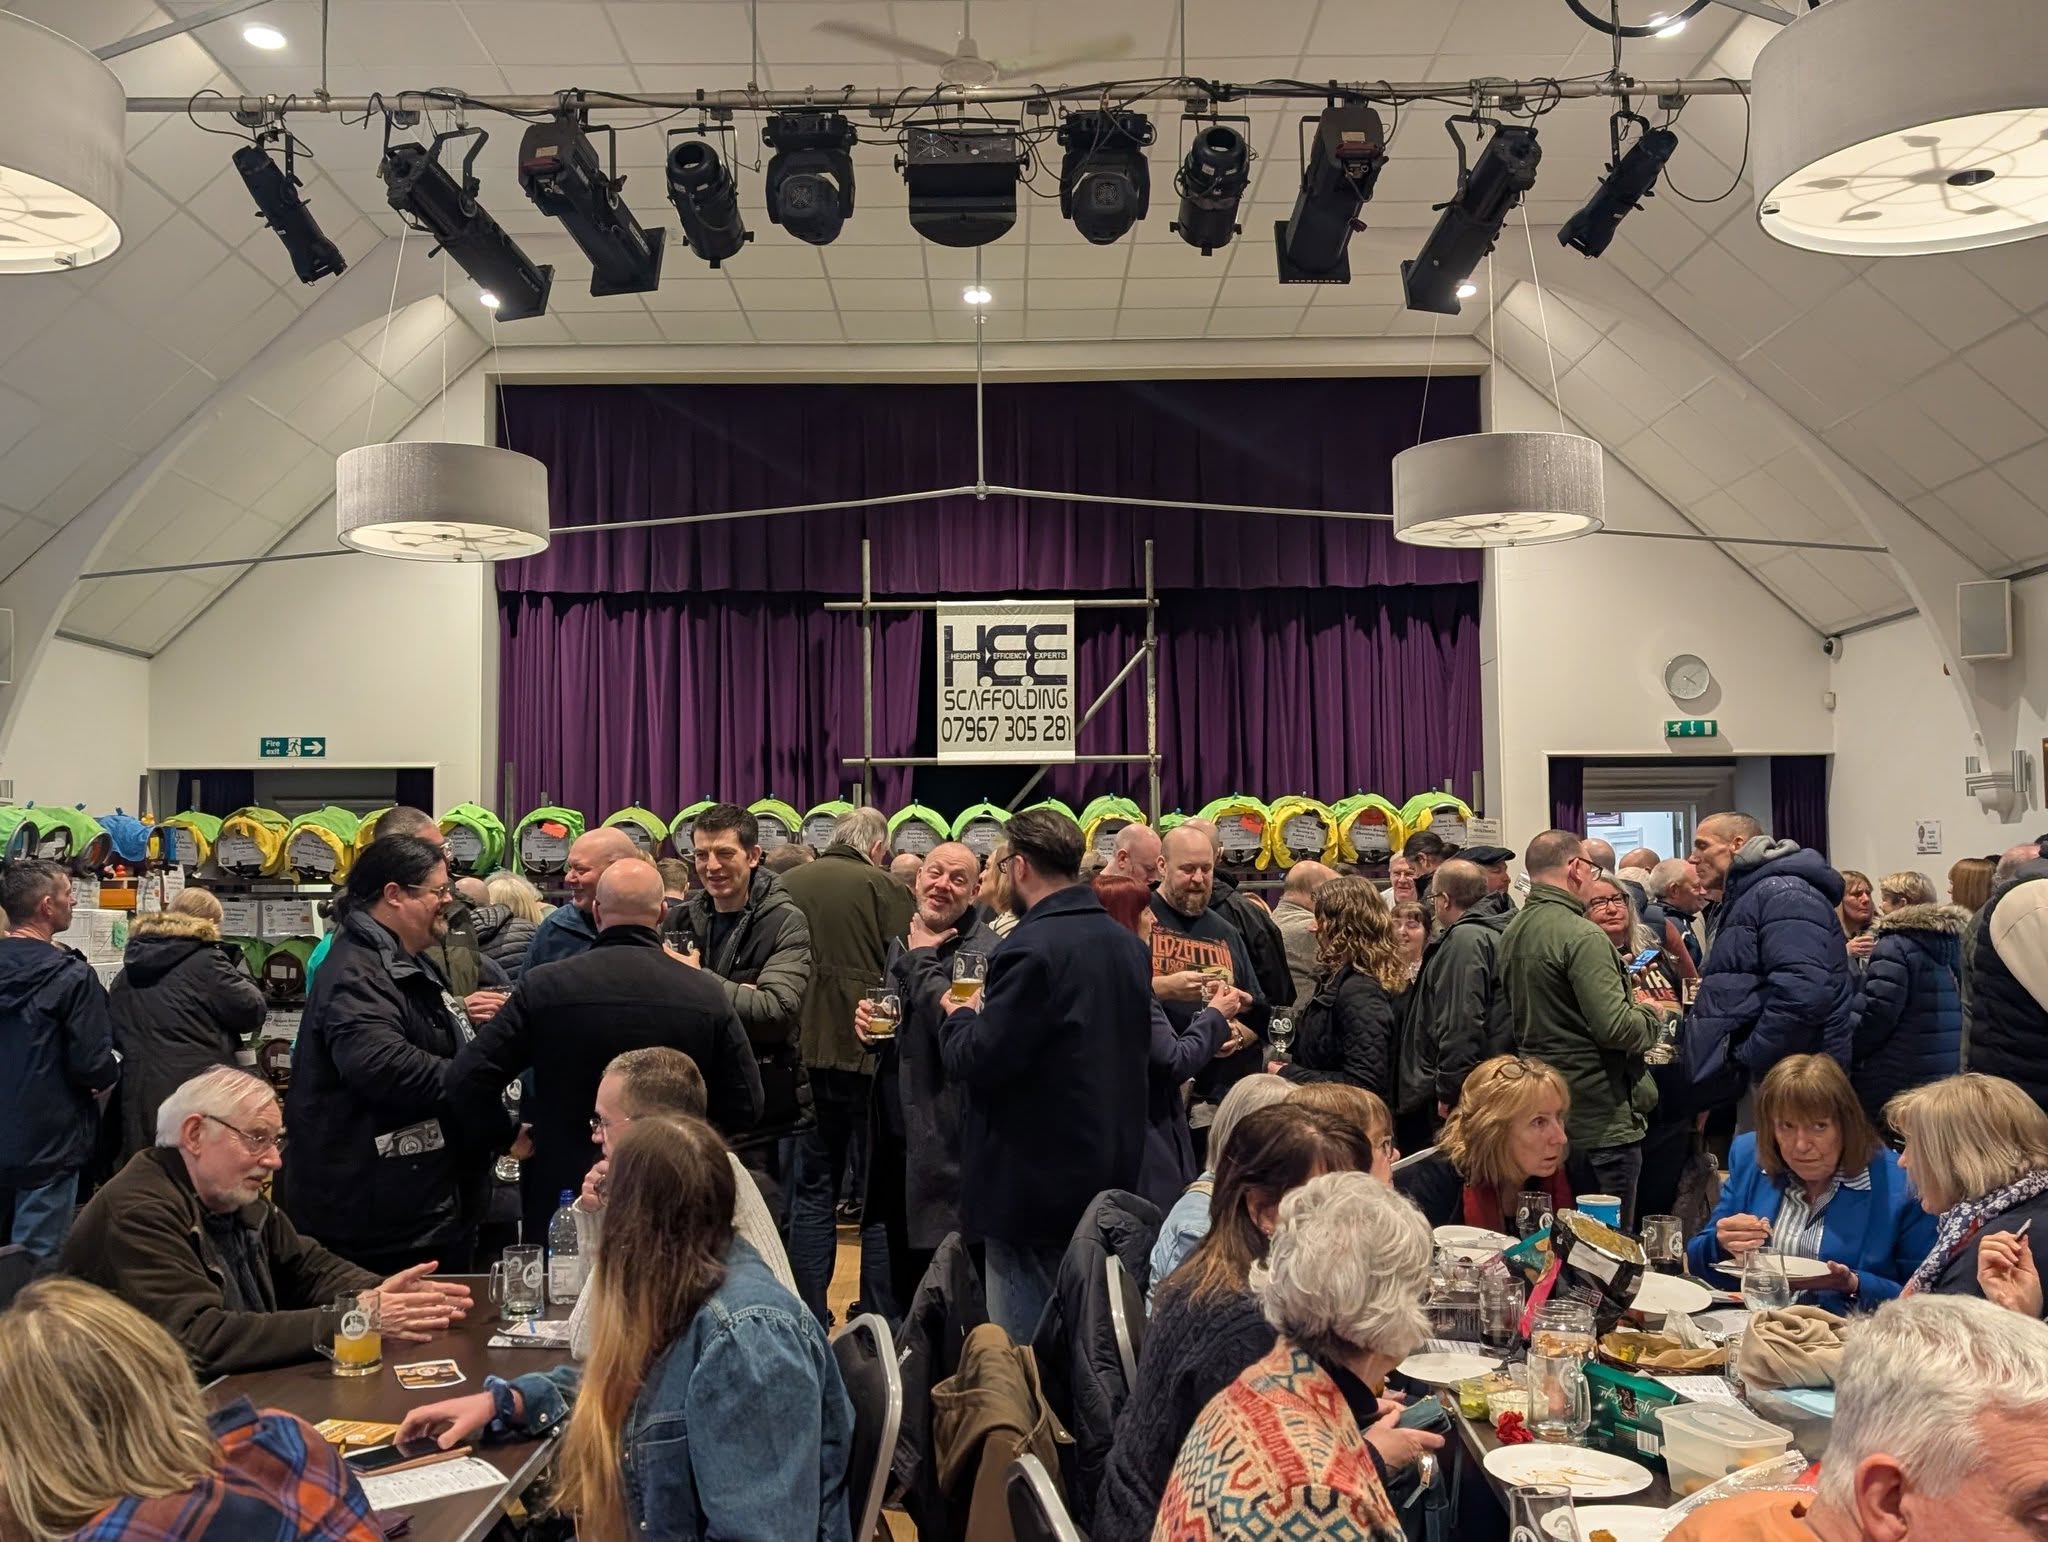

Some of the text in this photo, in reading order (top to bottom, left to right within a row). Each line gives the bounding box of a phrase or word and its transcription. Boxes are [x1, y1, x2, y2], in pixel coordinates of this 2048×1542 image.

[950, 651, 1066, 661] HEIGHTS EFFICIENCY EXPERTS
[944, 688, 1068, 711] SCAFFOLDING
[941, 715, 1072, 743] 07967 305 281
